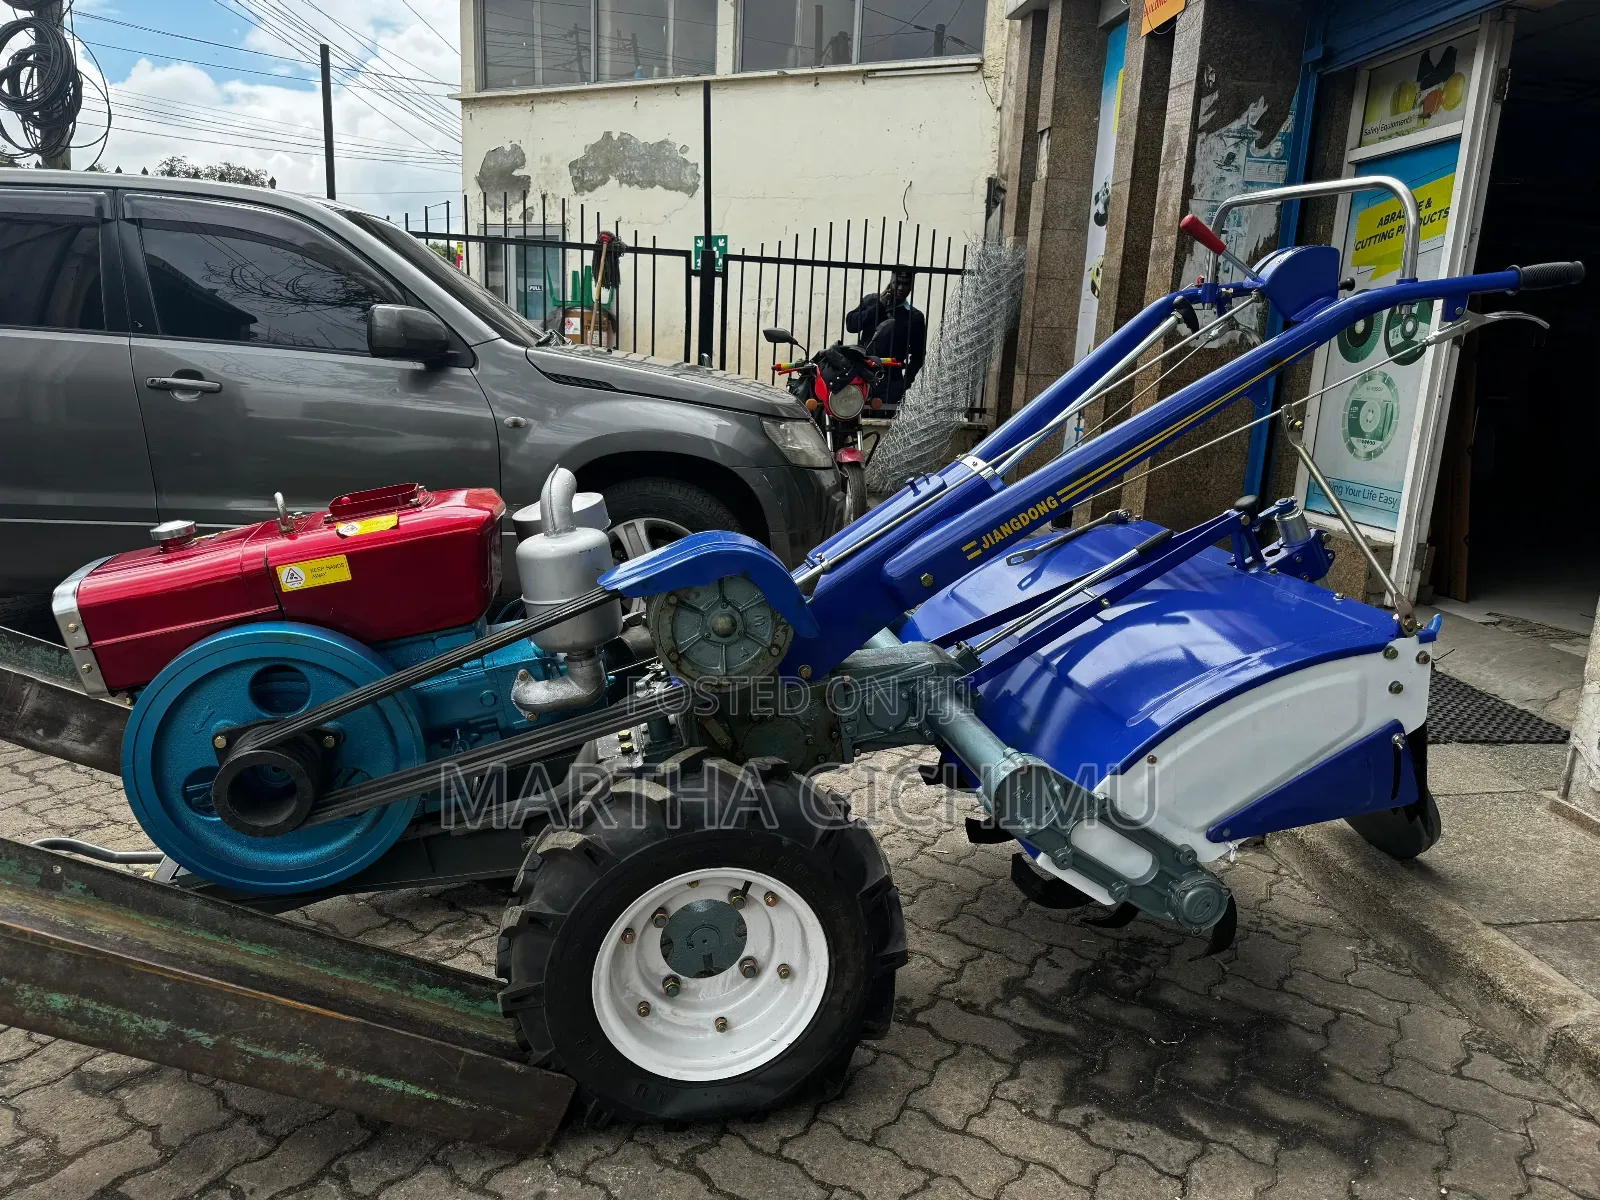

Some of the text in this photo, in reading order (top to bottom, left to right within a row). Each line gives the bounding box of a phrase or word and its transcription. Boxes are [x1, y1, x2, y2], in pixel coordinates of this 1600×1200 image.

[1364, 123, 1381, 136] Safety
[1425, 197, 1433, 210] &
[1355, 228, 1395, 251] CUTTING
[1345, 484, 1361, 498] Your
[1362, 489, 1377, 501] Life
[1378, 493, 1398, 508] Easy
[982, 496, 1059, 549] JIANGDONG
